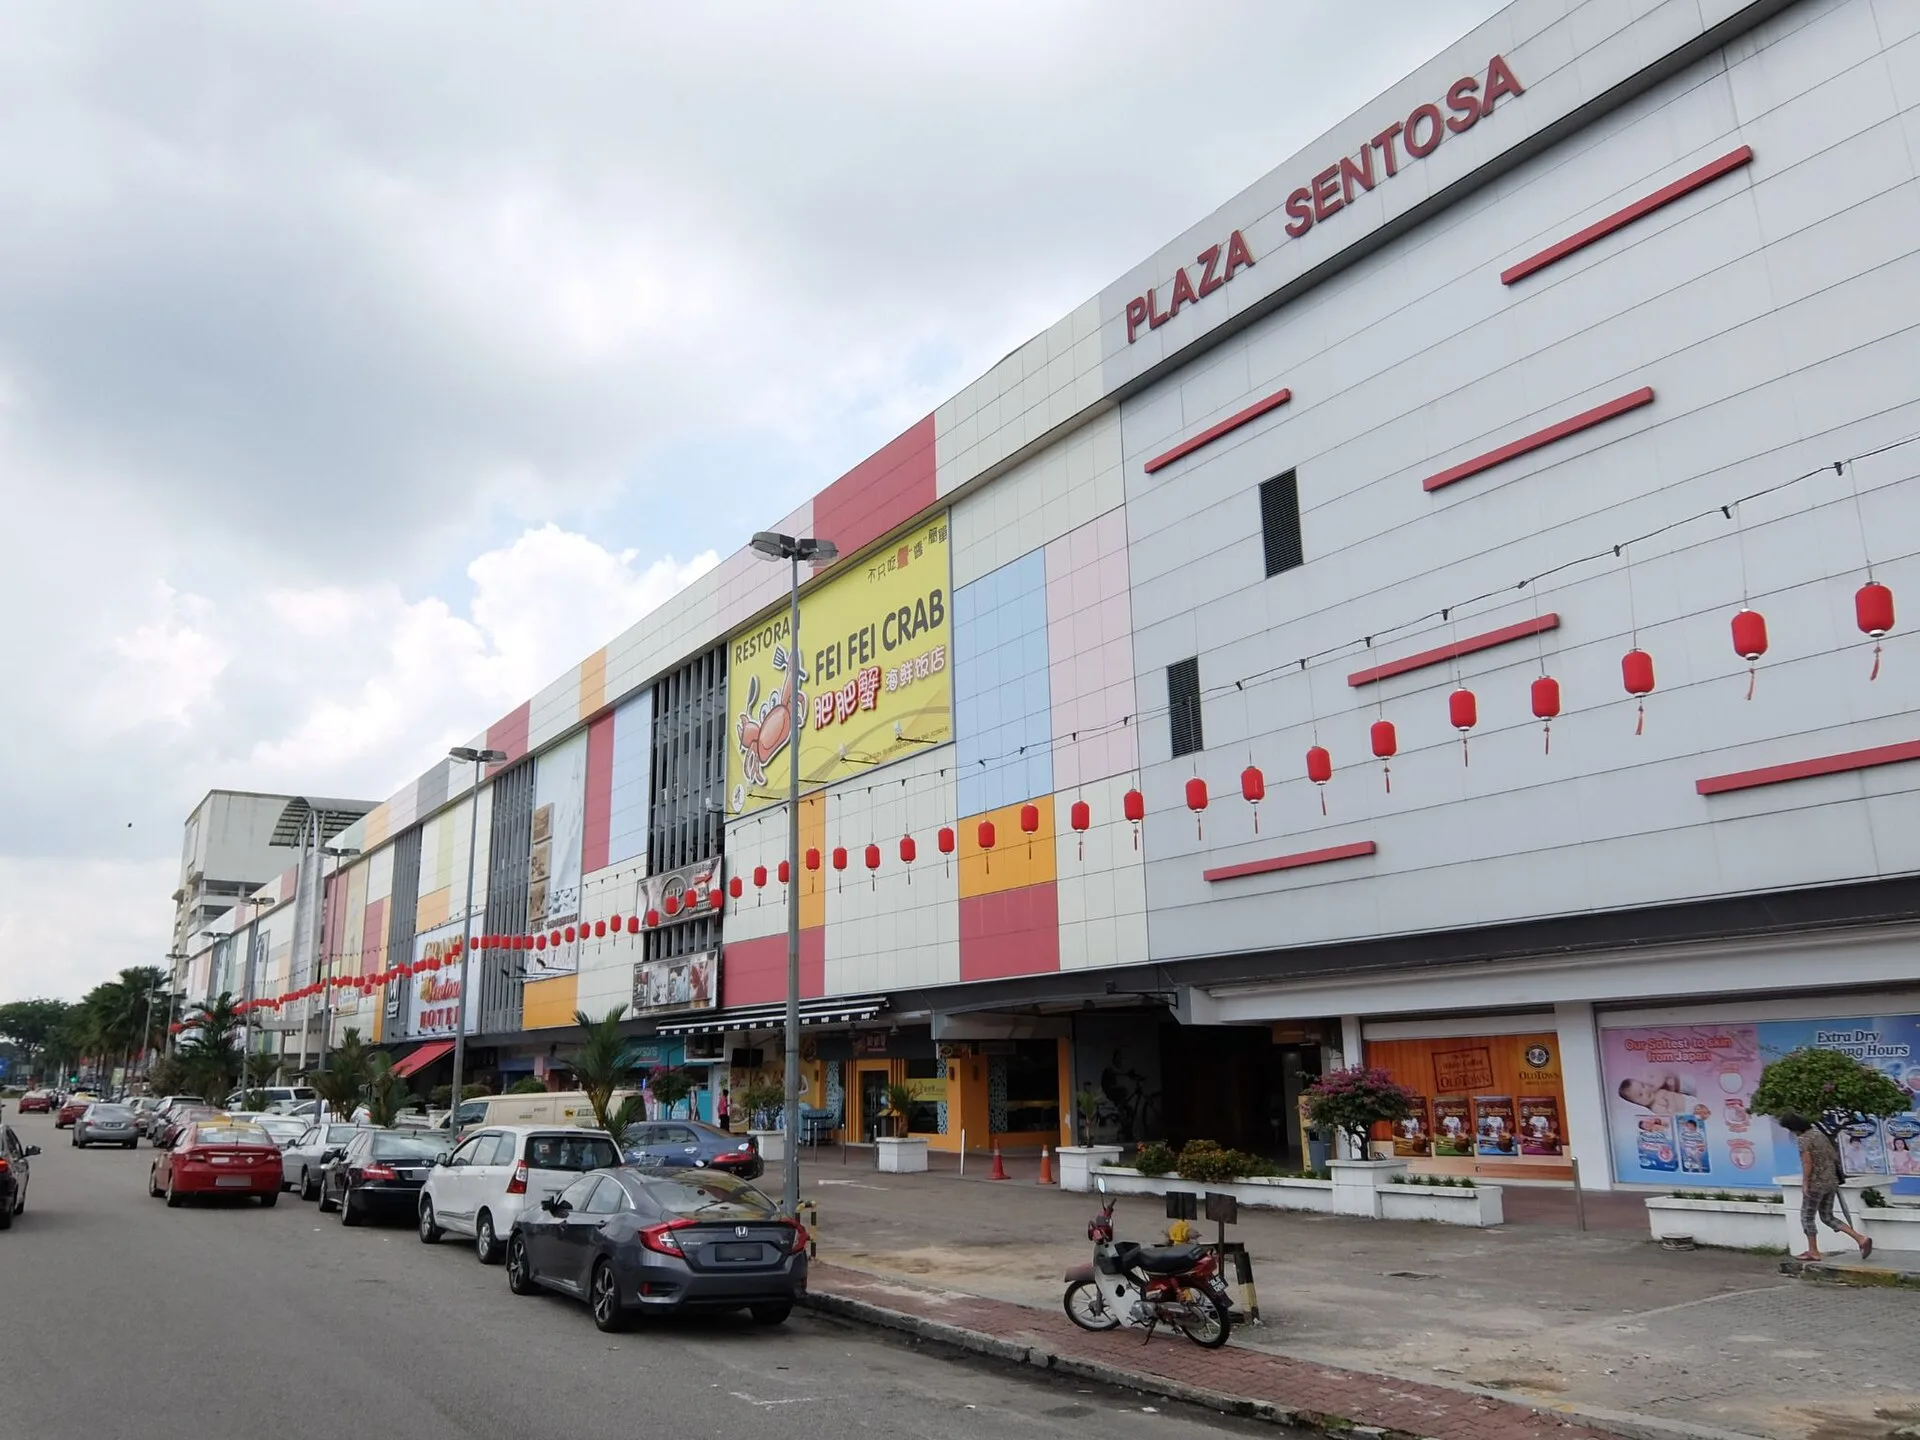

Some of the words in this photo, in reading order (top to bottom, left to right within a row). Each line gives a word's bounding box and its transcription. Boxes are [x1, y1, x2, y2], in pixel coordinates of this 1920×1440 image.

[1126, 229, 1256, 344] PLAZA
[1284, 54, 1526, 238] SENTOSA
[735, 610, 801, 666] RESTORA
[815, 640, 841, 686] FEI
[848, 623, 875, 670] FEI
[882, 588, 945, 651] CRAB
[814, 665, 881, 730] 肥肥蟹
[1625, 1039, 1647, 1051] Our
[1648, 1038, 1689, 1051] Softest
[1693, 1037, 1705, 1050] to
[1707, 1035, 1732, 1049] skin
[1817, 1031, 1851, 1044] Extra
[1855, 1030, 1880, 1045] Dry
[1867, 1044, 1909, 1057] Hours
[1647, 1051, 1674, 1063] from
[1675, 1050, 1712, 1064] Japan
